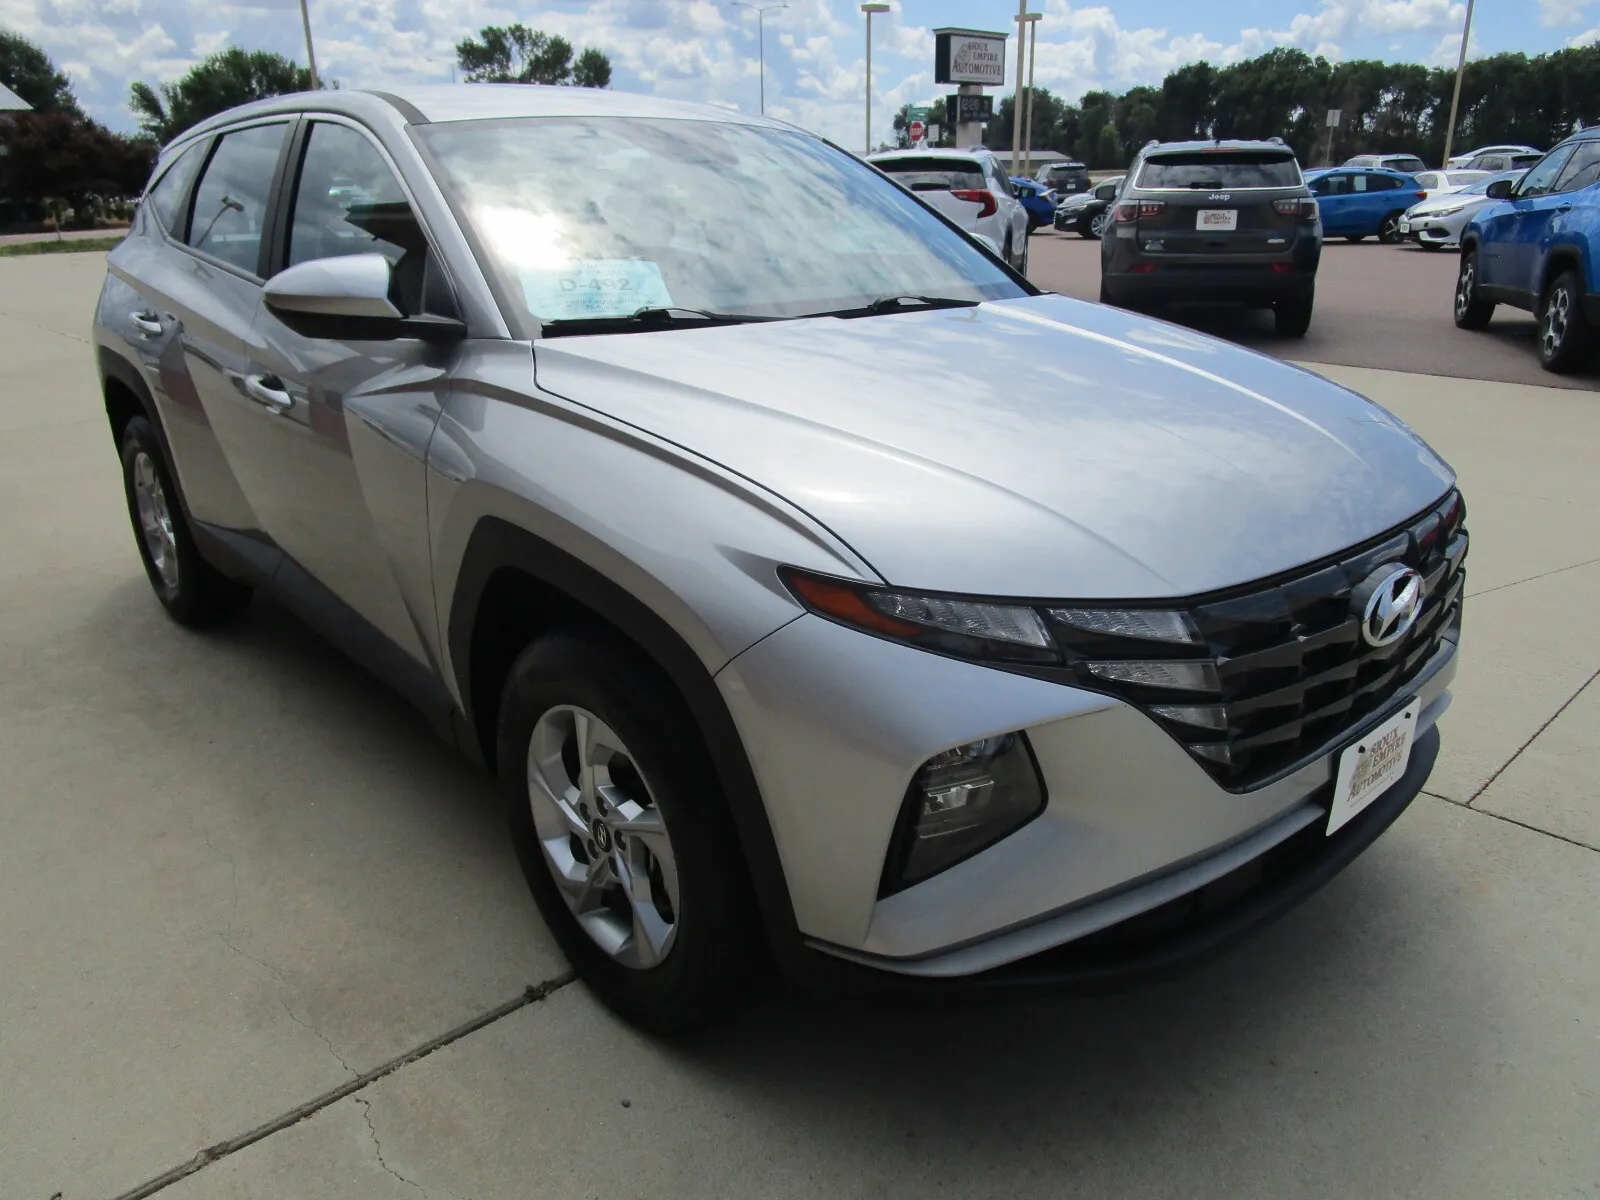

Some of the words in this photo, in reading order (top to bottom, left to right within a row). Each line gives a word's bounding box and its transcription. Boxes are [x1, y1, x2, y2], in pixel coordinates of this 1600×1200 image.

[968, 42, 988, 51] SIOUX
[973, 52, 998, 61] EMPIRE
[952, 60, 1001, 75] AUTOMOTIVE
[1208, 193, 1230, 201] Jeep
[559, 278, 632, 291] D-492
[1369, 727, 1399, 757] SIOUX
[1372, 731, 1407, 768] EMPIRE
[1346, 749, 1403, 802] AUTOMOTIVE
